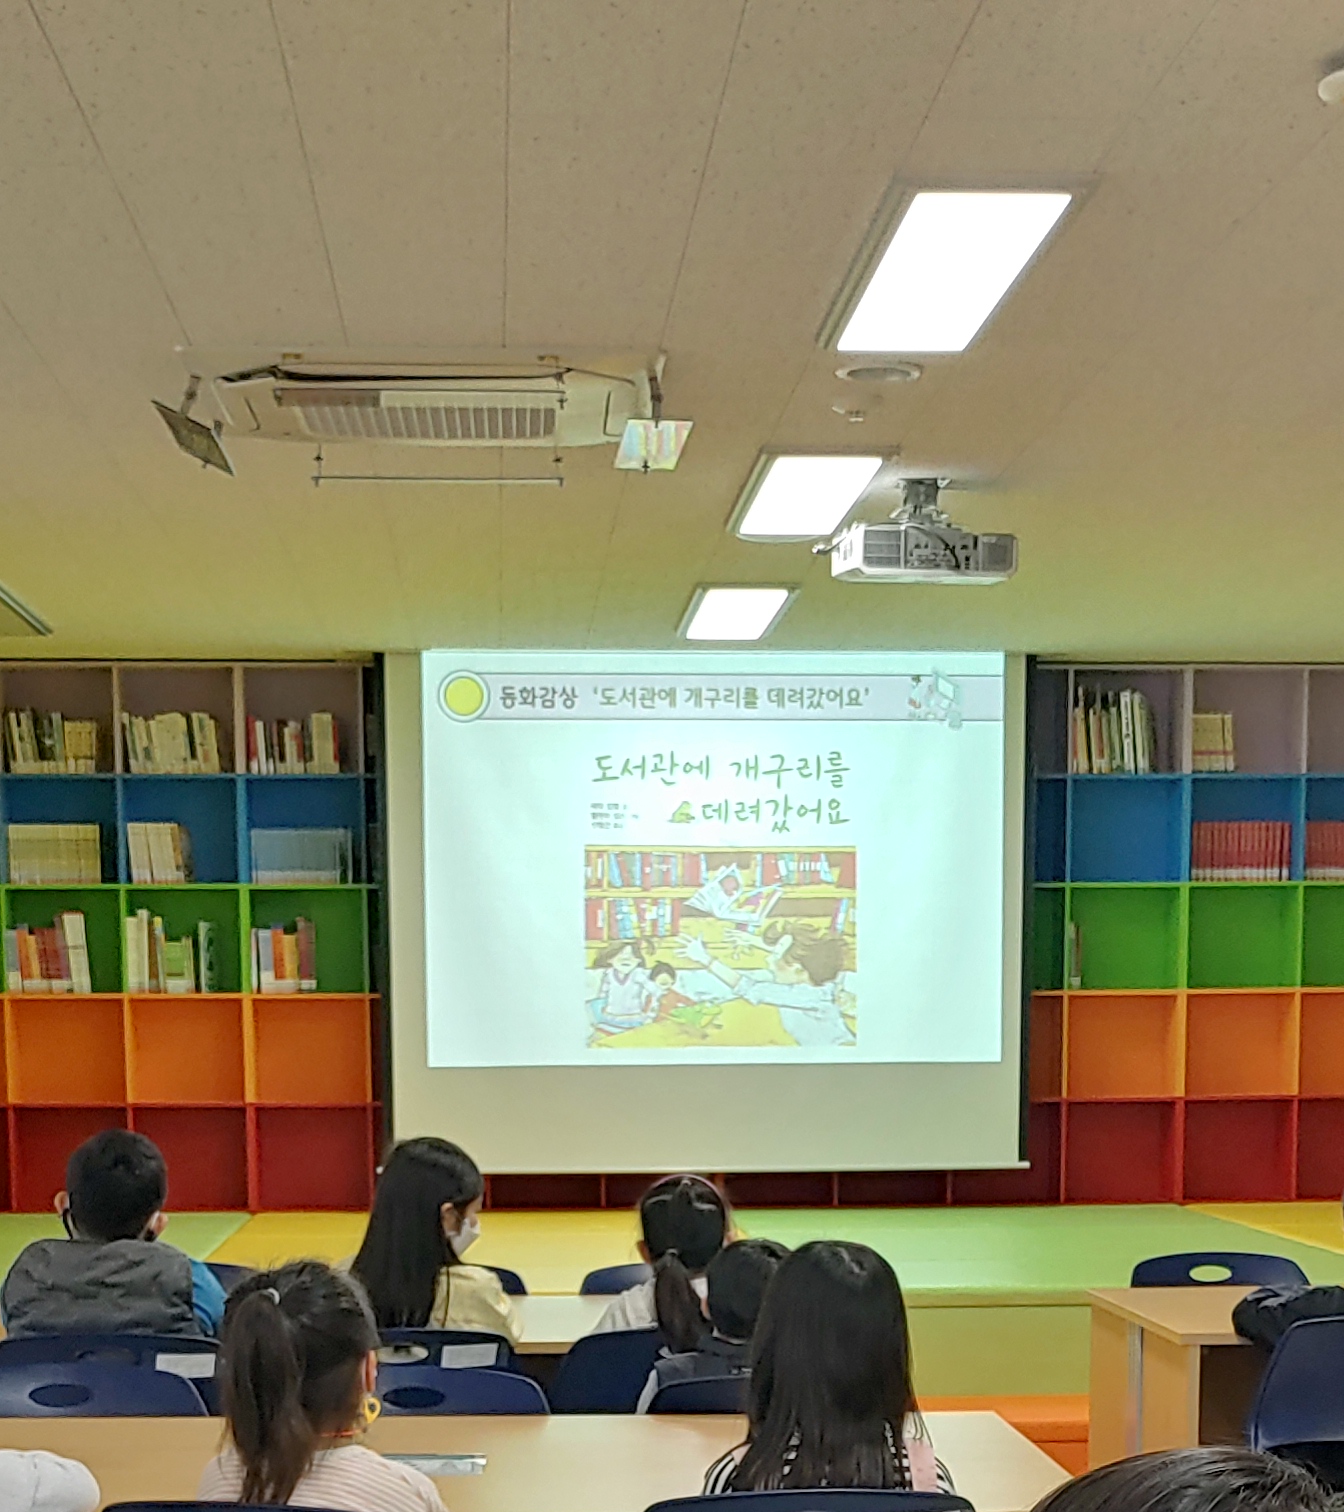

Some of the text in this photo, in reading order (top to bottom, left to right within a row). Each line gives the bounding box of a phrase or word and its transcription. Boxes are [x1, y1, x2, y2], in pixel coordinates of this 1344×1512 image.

[683, 687, 759, 709] 개구리를
[592, 750, 851, 789] 도서관에 개구리를
[701, 794, 850, 833] 데려갔어요
